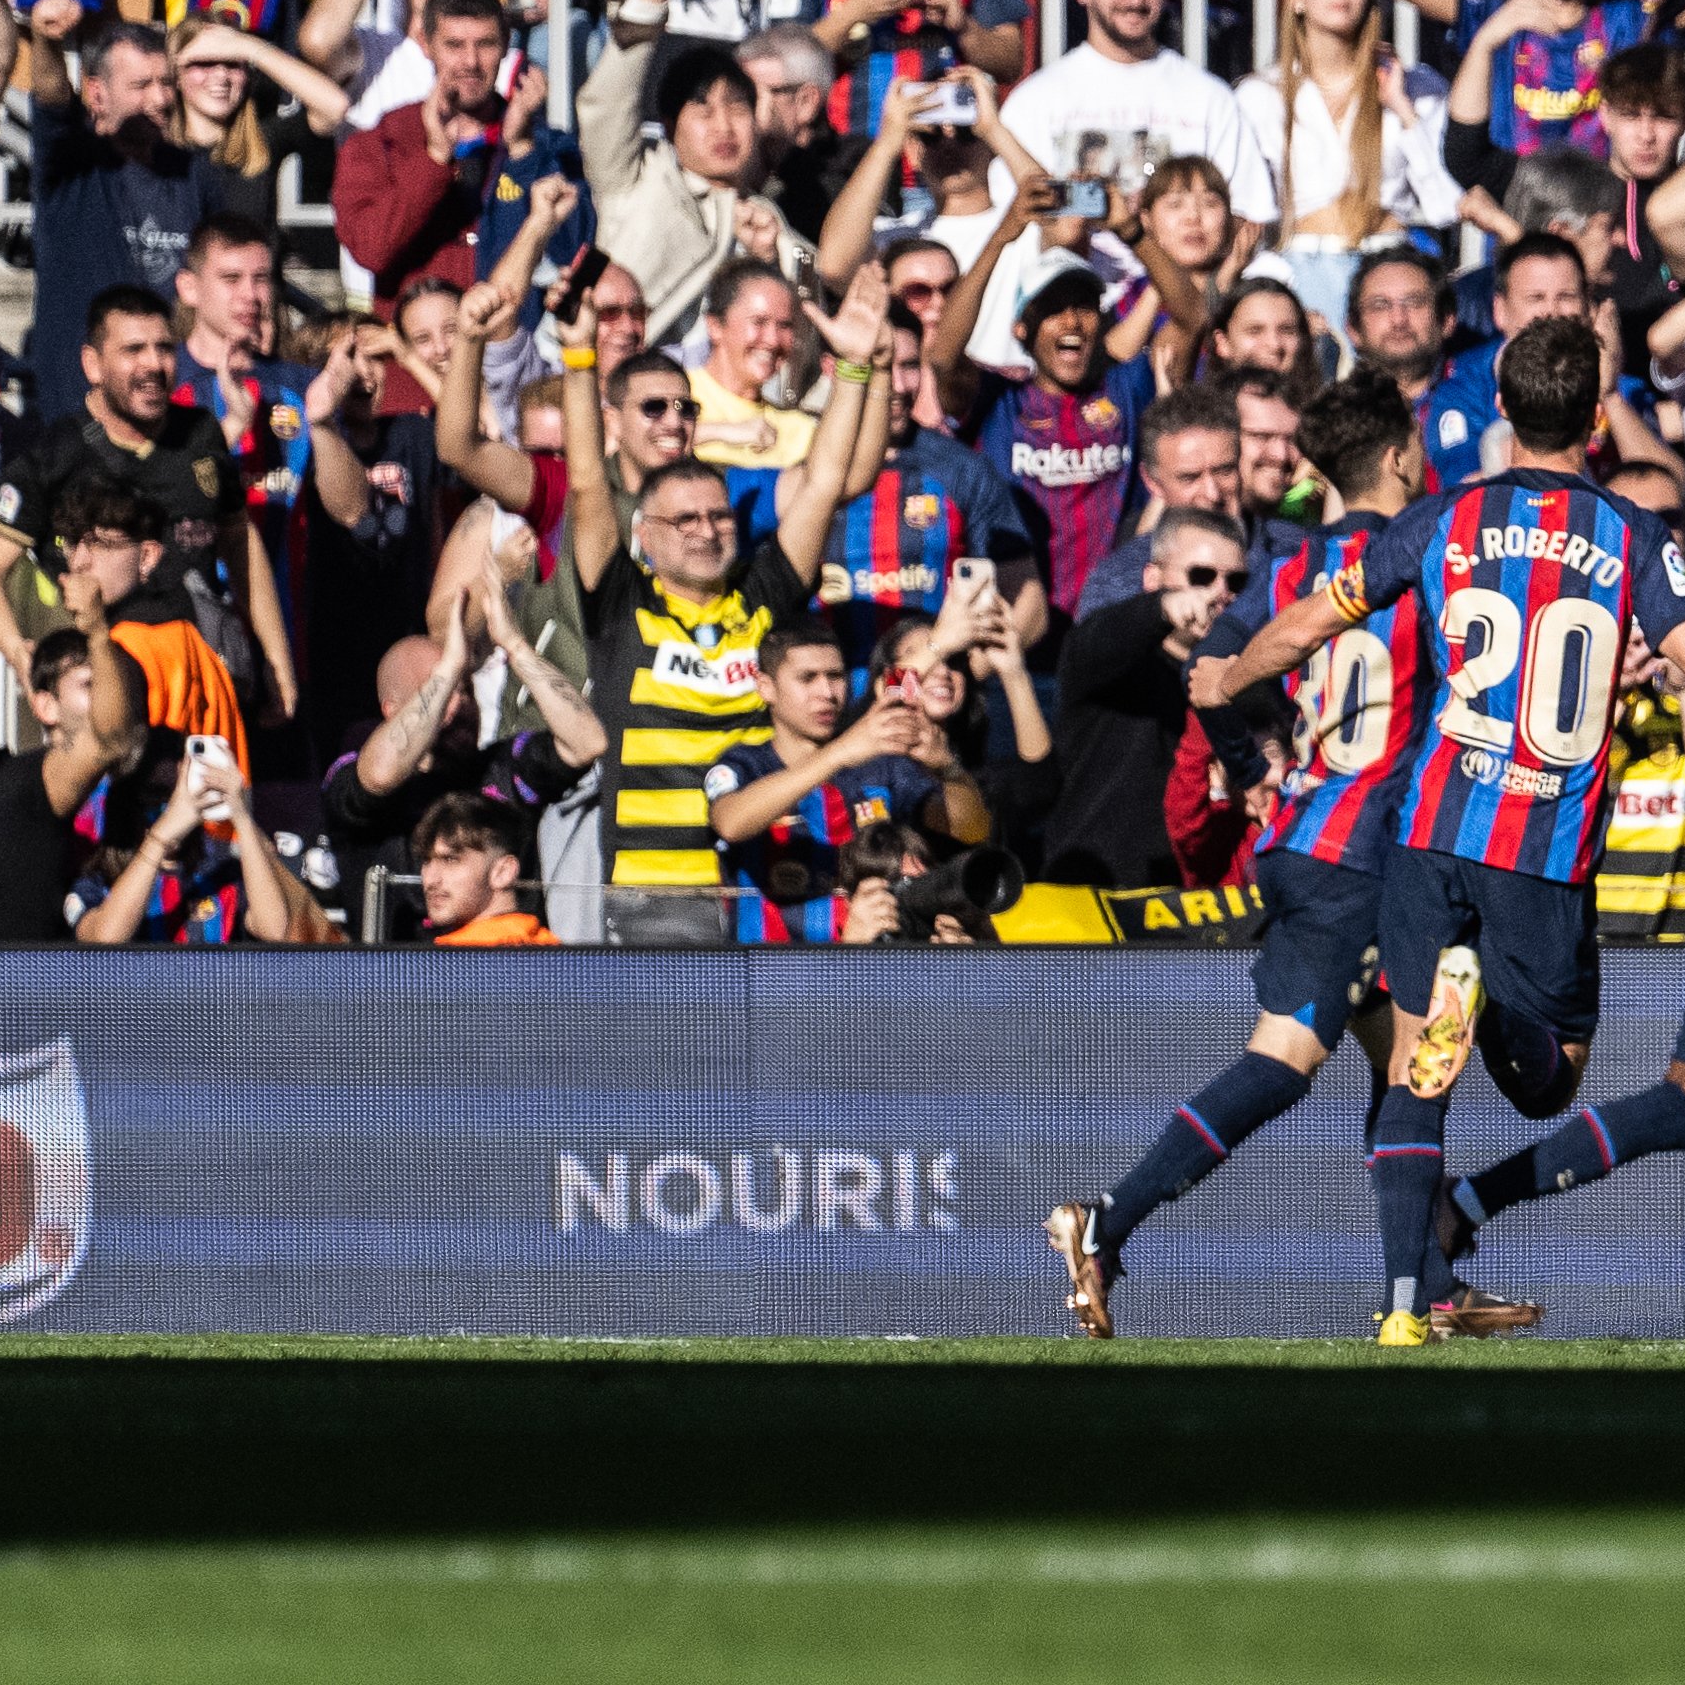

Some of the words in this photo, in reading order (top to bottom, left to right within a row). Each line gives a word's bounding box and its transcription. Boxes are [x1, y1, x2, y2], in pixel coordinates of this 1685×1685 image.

[1011, 440, 1133, 487] Rakute
[1482, 524, 1624, 589] ROBERTO
[1437, 586, 1621, 767] 20
